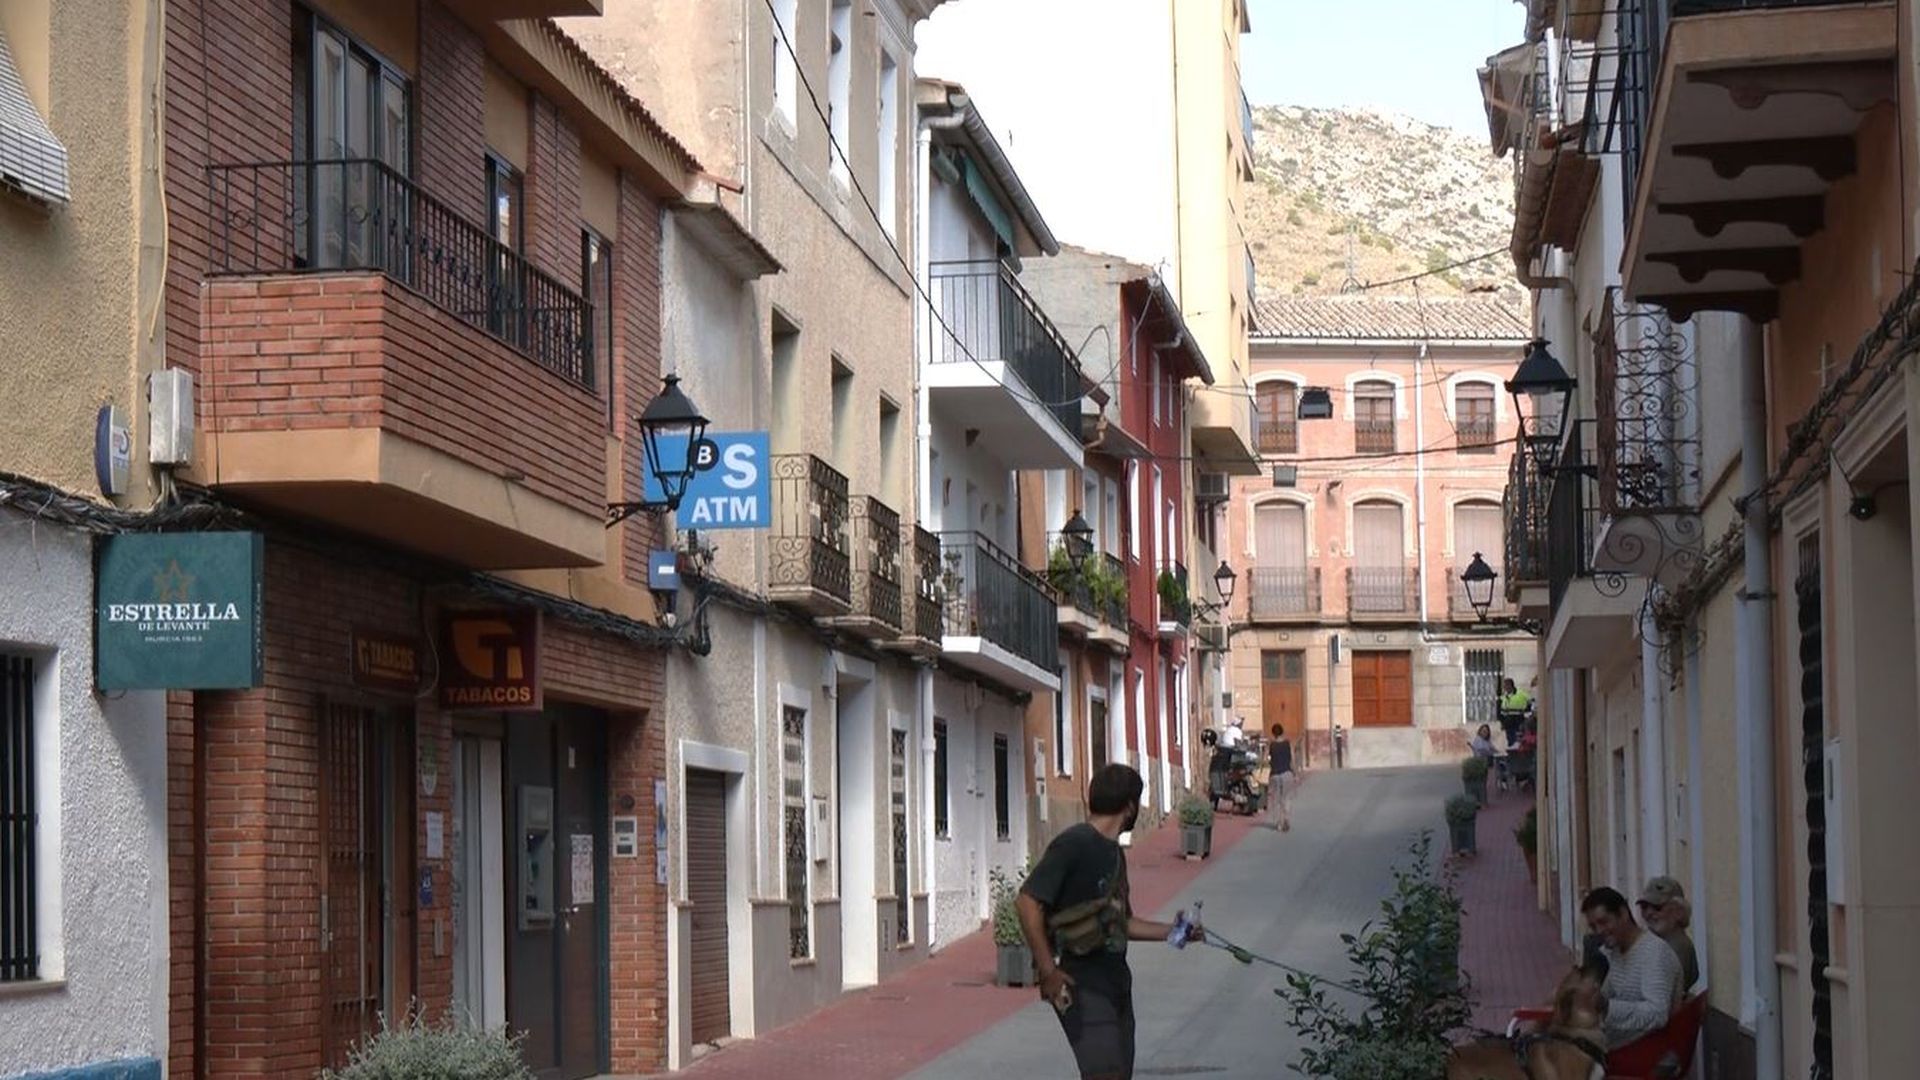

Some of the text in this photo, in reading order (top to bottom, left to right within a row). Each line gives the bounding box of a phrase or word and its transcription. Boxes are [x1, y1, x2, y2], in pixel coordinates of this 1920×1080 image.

[697, 443, 758, 490] B S
[691, 495, 758, 523] ATM
[108, 602, 240, 622] ESTRELLA
[138, 621, 210, 631] DE LEVANTE
[446, 685, 532, 704] TABACOS
